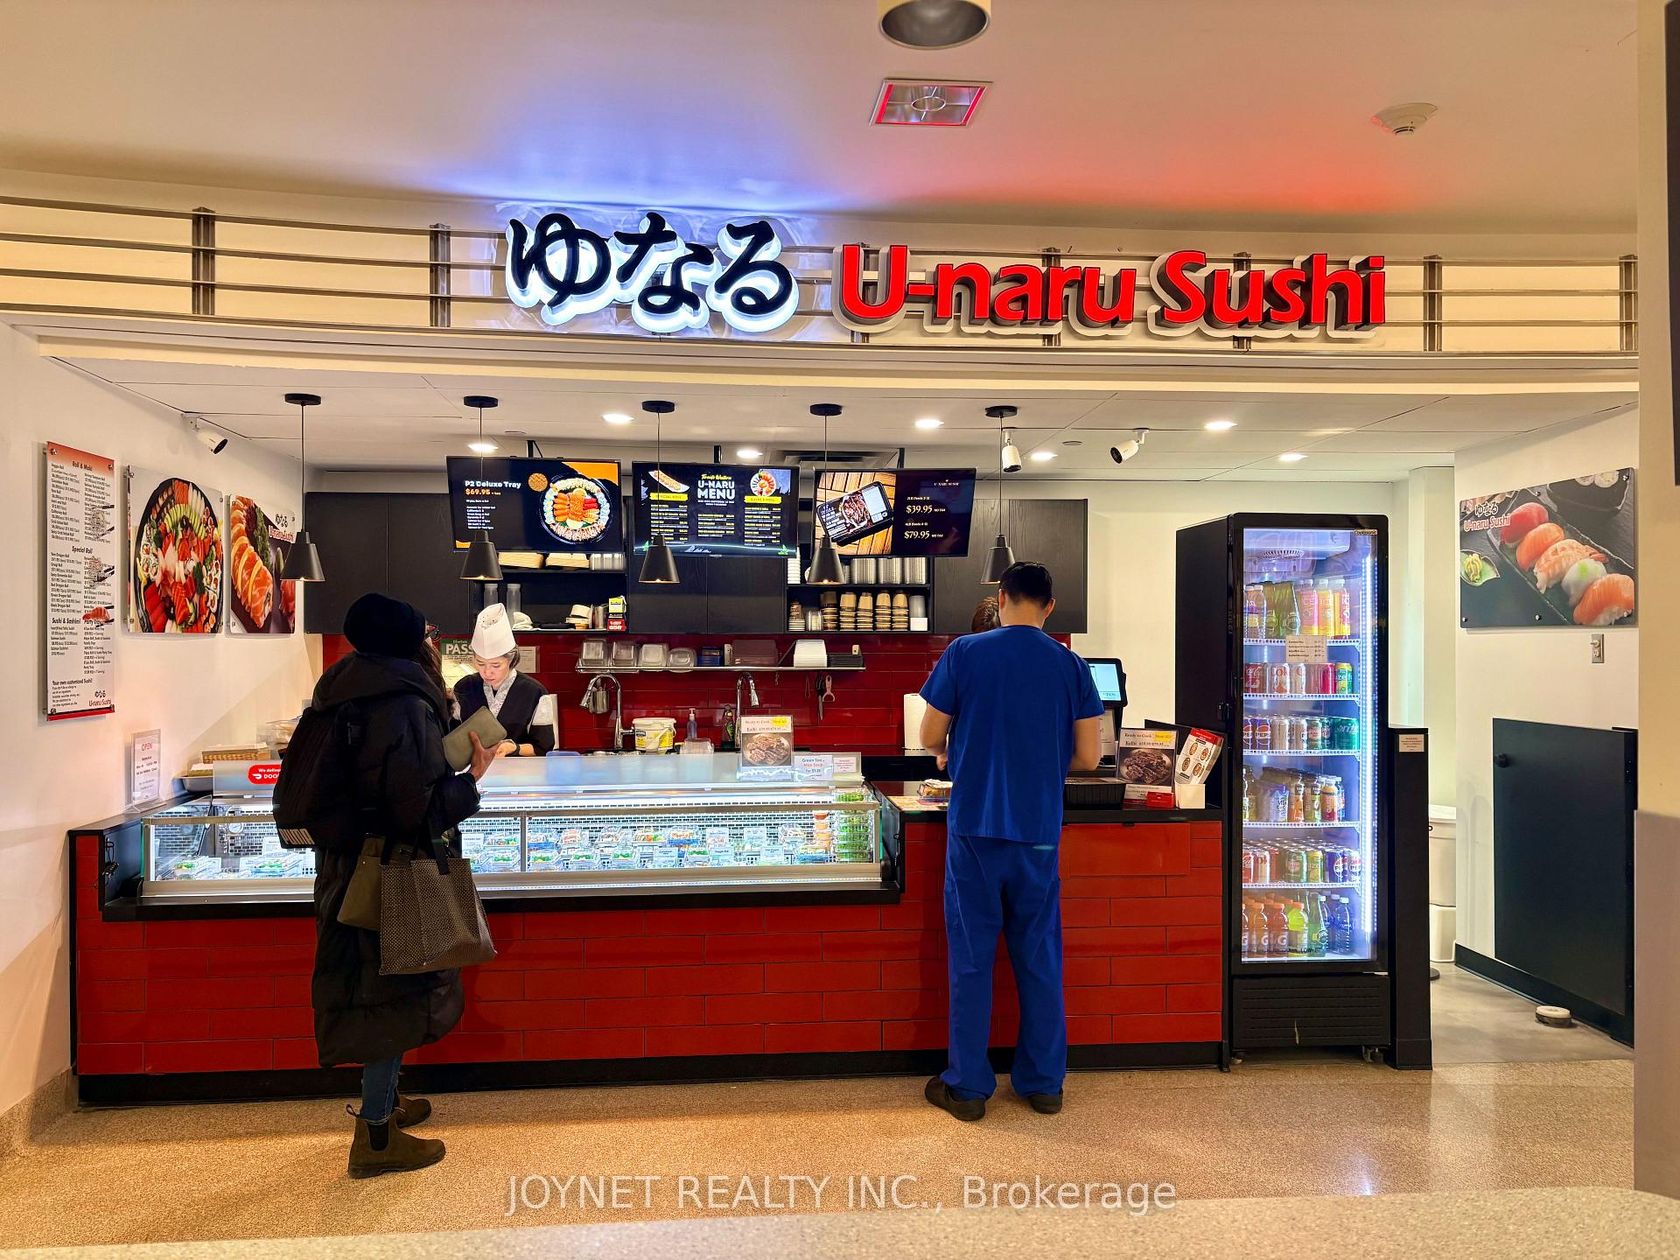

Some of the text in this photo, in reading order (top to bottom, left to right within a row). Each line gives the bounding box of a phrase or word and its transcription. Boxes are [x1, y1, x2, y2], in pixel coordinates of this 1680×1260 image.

[509, 211, 794, 315] ゆなる
[840, 244, 1387, 325] U-naru Sushi
[503, 481, 522, 489] Tray
[697, 480, 735, 489] U-NARU
[697, 488, 735, 500] MENU
[905, 504, 933, 514] $39.95
[1464, 513, 1511, 532] U-naru Sushi
[904, 530, 930, 540] $79.95
[446, 643, 474, 654] PASS
[278, 828, 315, 845] PUMA
